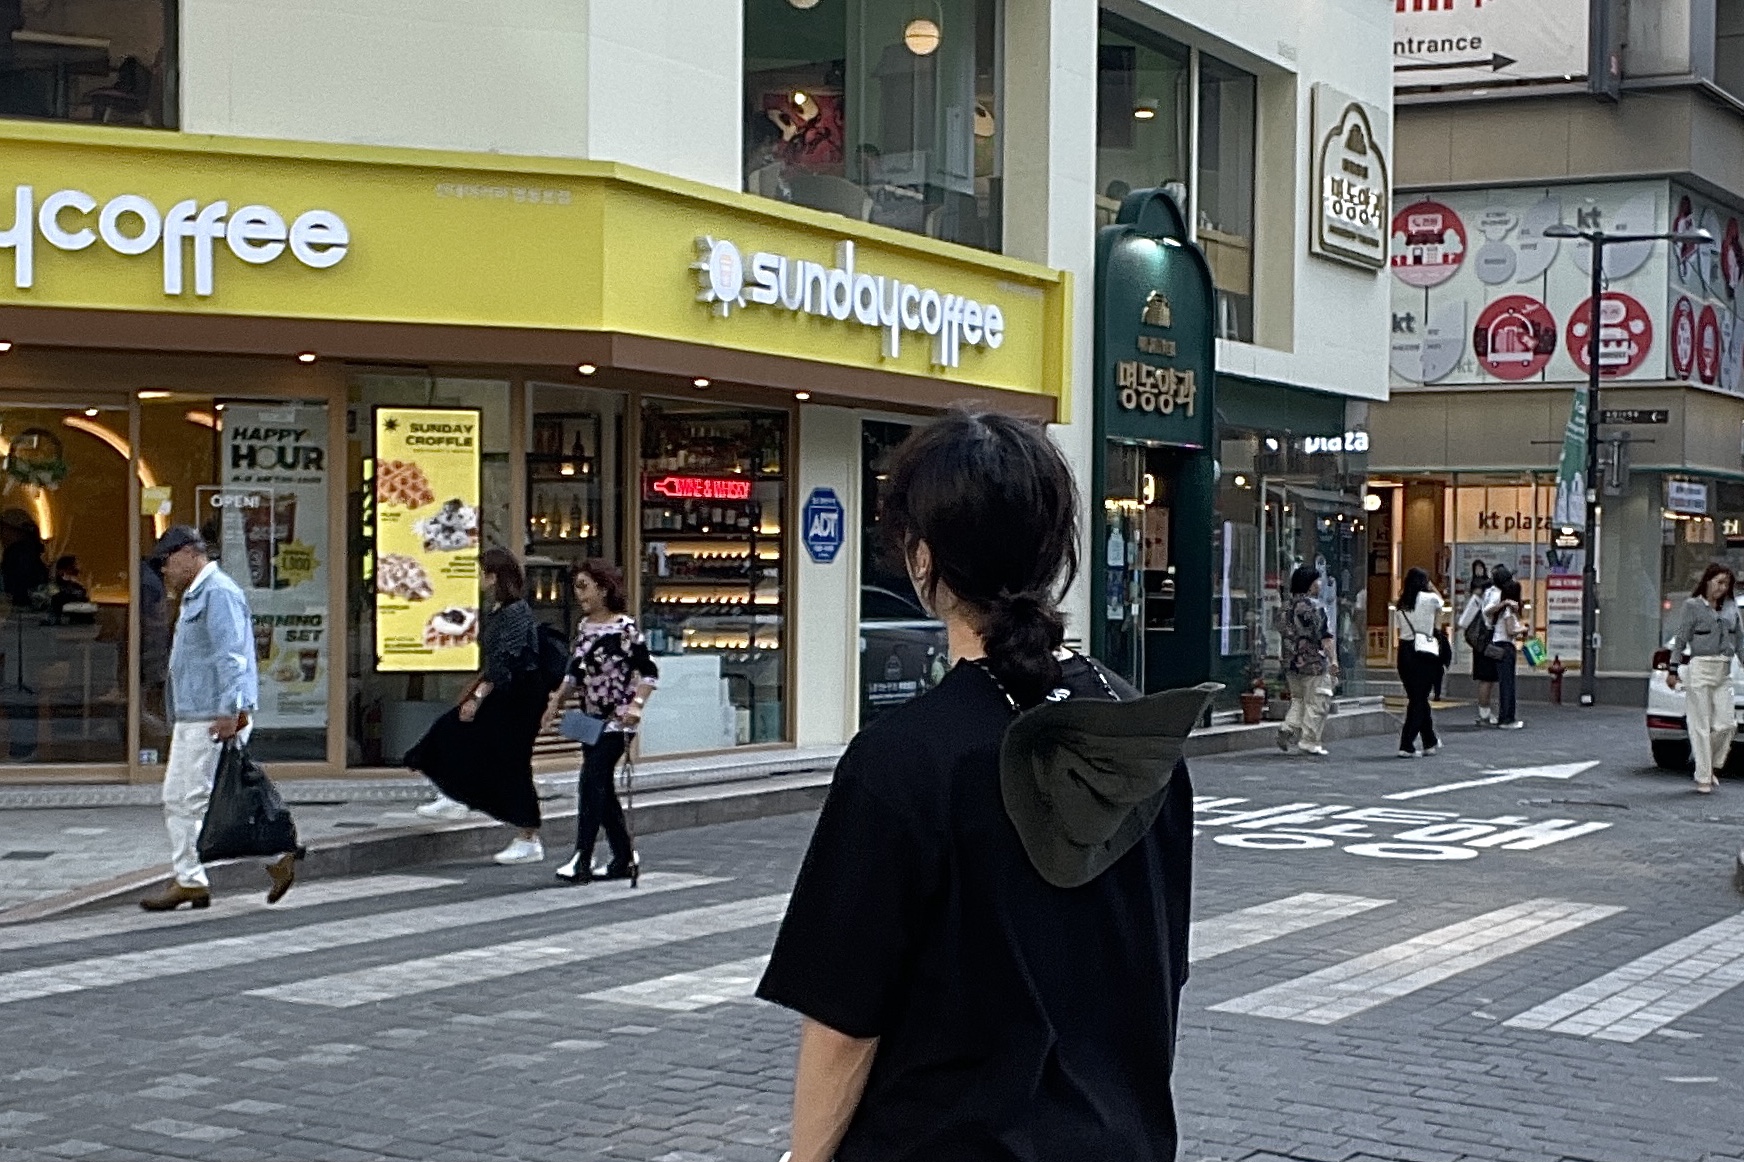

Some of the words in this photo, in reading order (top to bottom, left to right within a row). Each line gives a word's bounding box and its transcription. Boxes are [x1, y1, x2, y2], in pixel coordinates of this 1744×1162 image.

[751, 239, 1004, 368] sundaycoffee
[1116, 361, 1196, 417] 명동양과
[231, 427, 306, 442] HAPPY
[410, 422, 474, 434] SUNDAY
[405, 434, 473, 447] CROFFLE
[231, 444, 323, 471] HOUR
[809, 512, 839, 538] ADT
[1478, 511, 1500, 529] kt
[285, 629, 324, 642] SET
